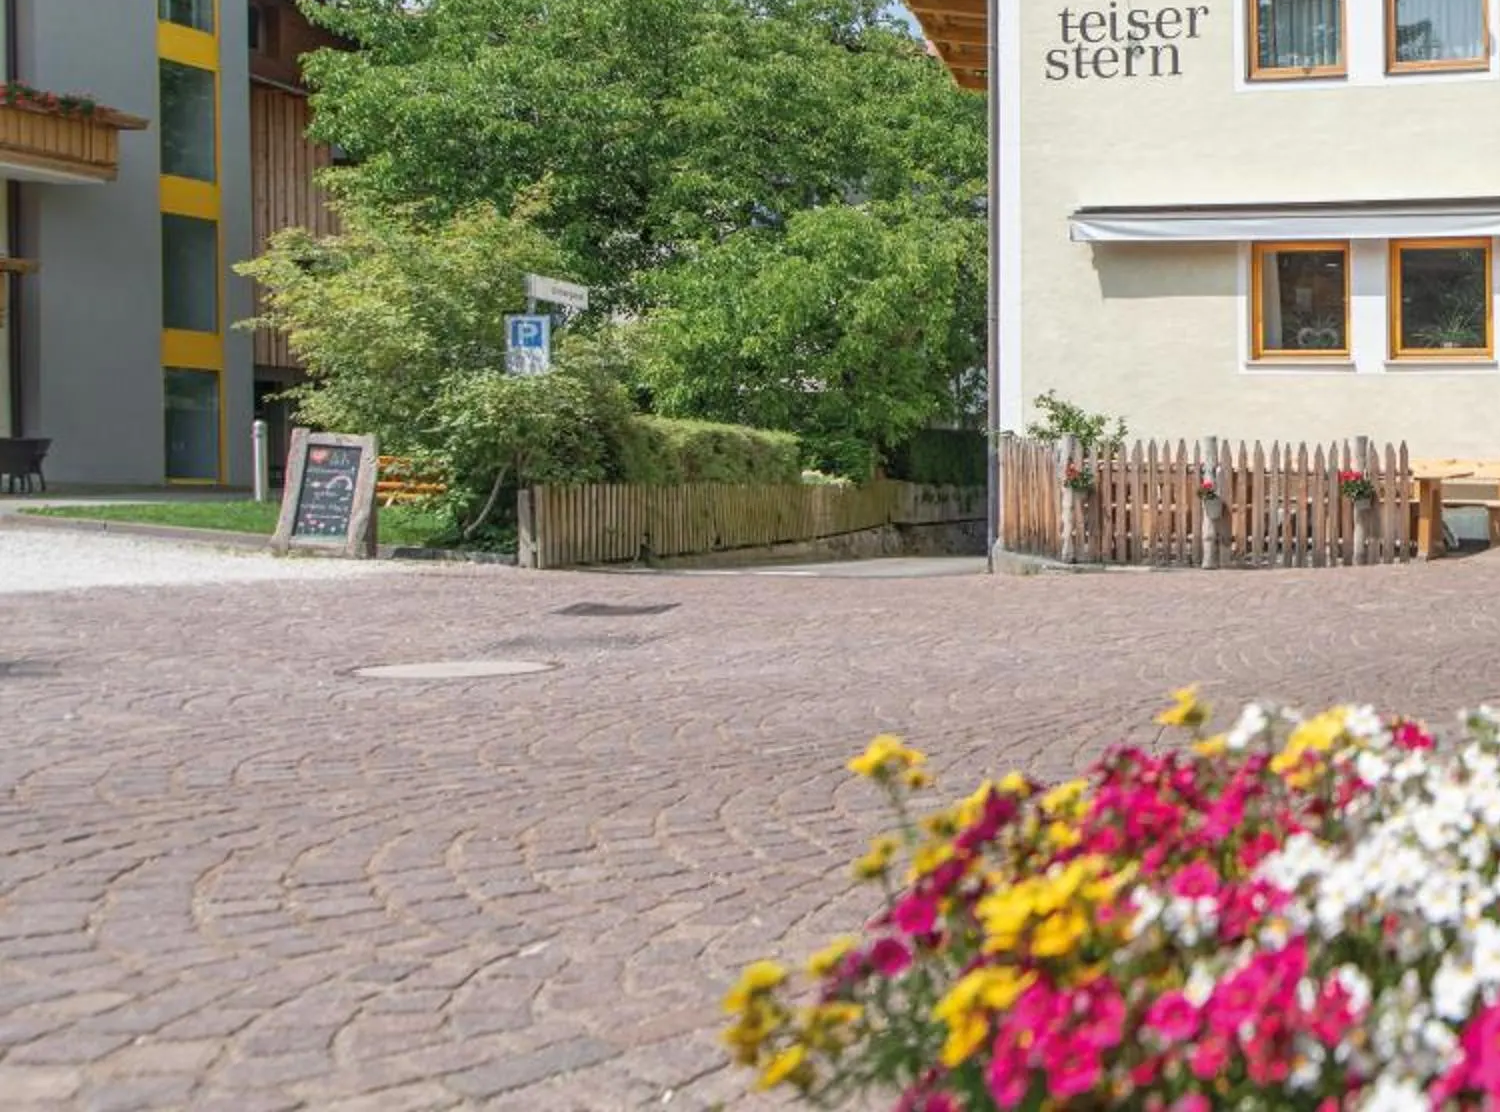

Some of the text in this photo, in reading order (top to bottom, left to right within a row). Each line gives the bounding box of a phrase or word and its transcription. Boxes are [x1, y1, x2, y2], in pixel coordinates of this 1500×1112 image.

[1058, 1, 1209, 44] teiser
[1045, 42, 1183, 81] stern
[517, 322, 539, 347] P
